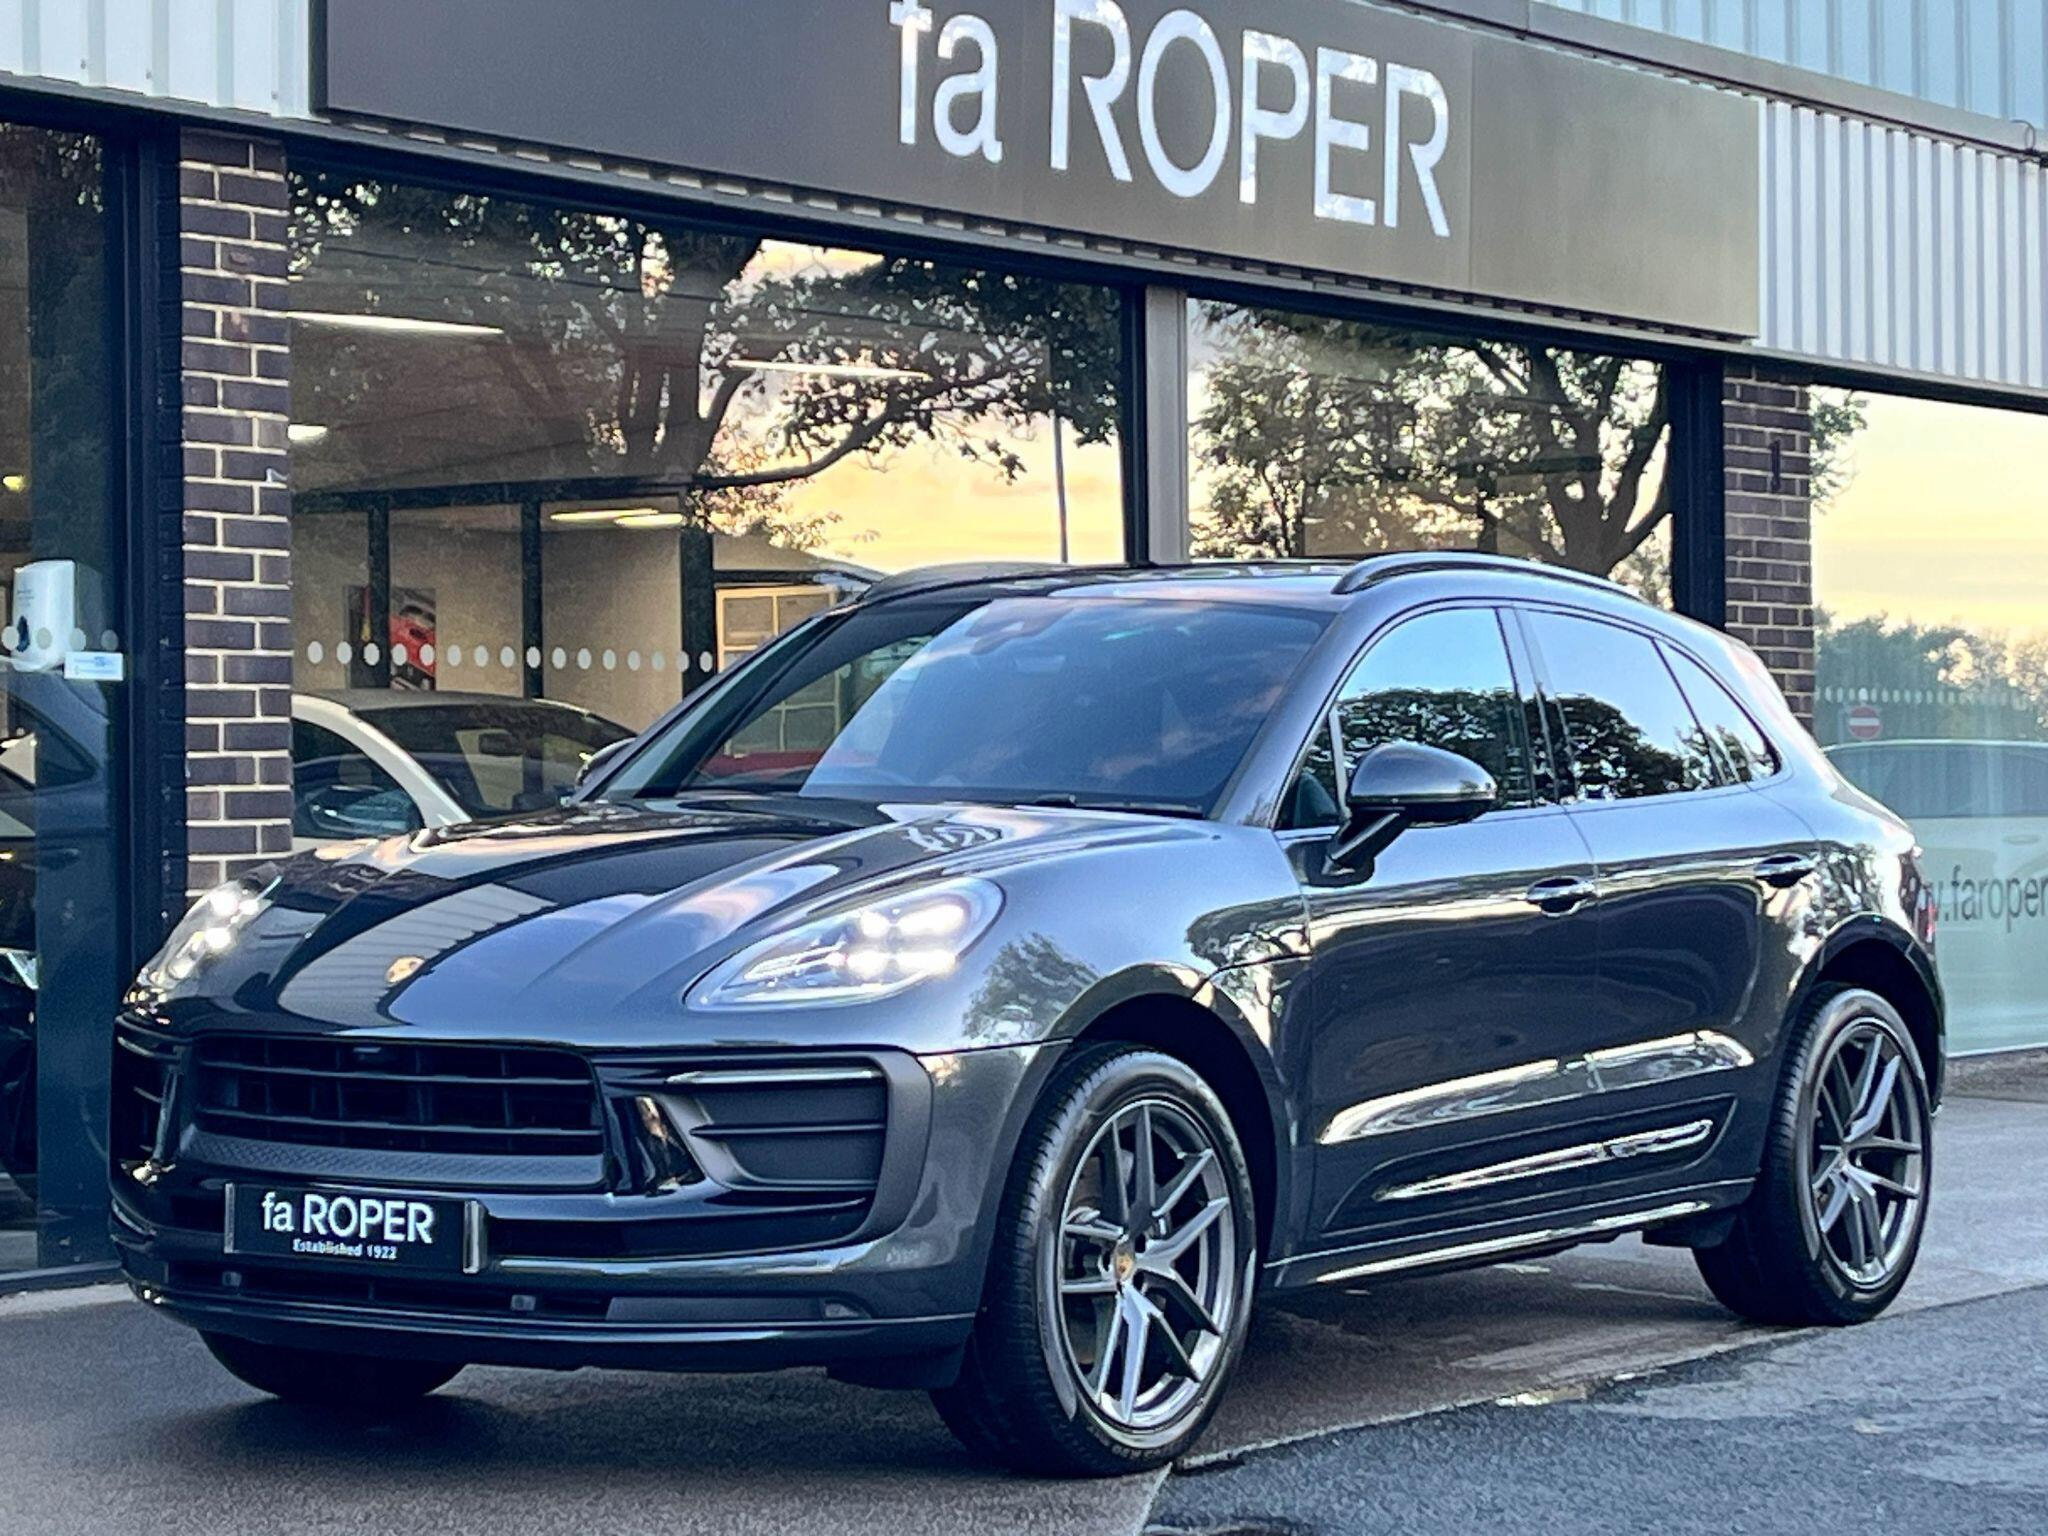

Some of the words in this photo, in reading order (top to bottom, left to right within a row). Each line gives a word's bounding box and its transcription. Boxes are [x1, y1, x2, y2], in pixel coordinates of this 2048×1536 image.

[890, 0, 1003, 162] fa
[1050, 0, 1451, 237] ROPER
[262, 1192, 295, 1232] fa
[303, 1194, 434, 1243] ROPER
[292, 1238, 362, 1257] Established
